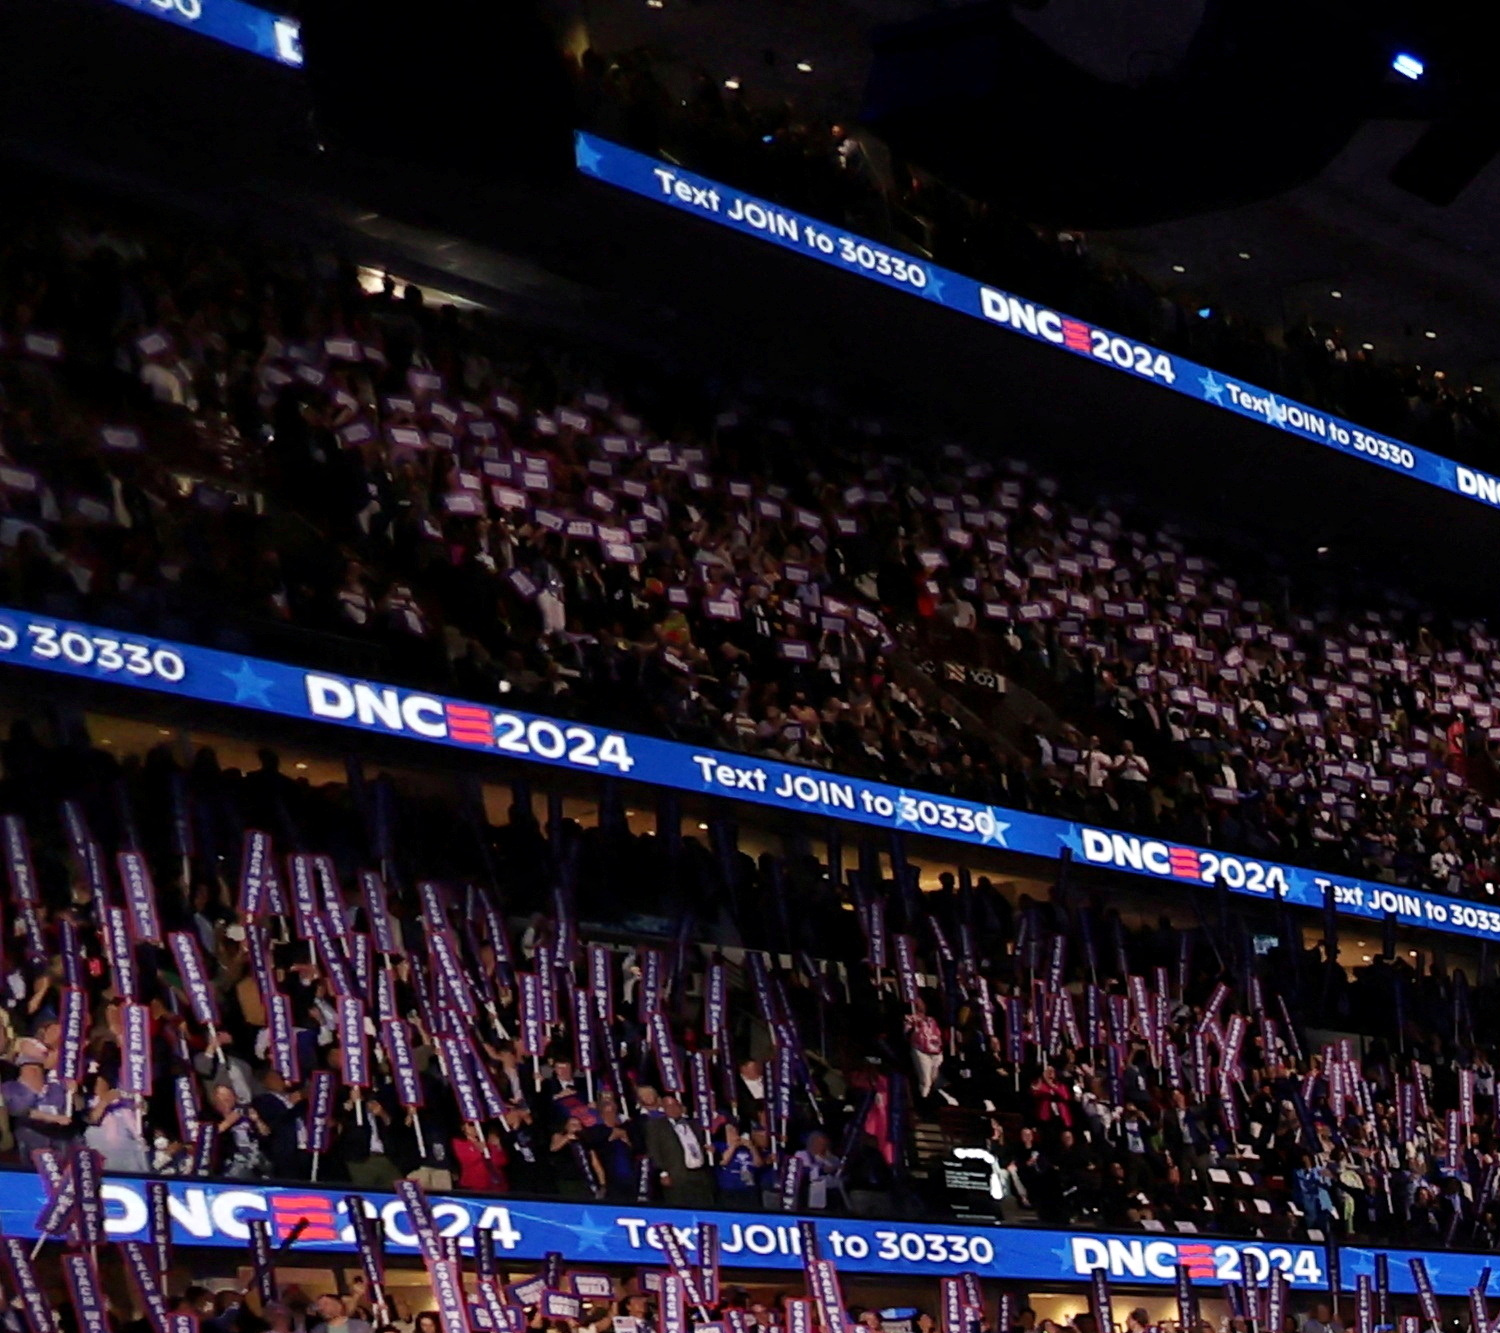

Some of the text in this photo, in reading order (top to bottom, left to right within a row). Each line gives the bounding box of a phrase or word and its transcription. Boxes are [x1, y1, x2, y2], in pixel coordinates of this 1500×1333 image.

[655, 169, 925, 287] Text JOIN to 30330
[694, 756, 995, 842] Text JOIN to 30330
[829, 1231, 868, 1257] to
[876, 1232, 993, 1263] 30330
